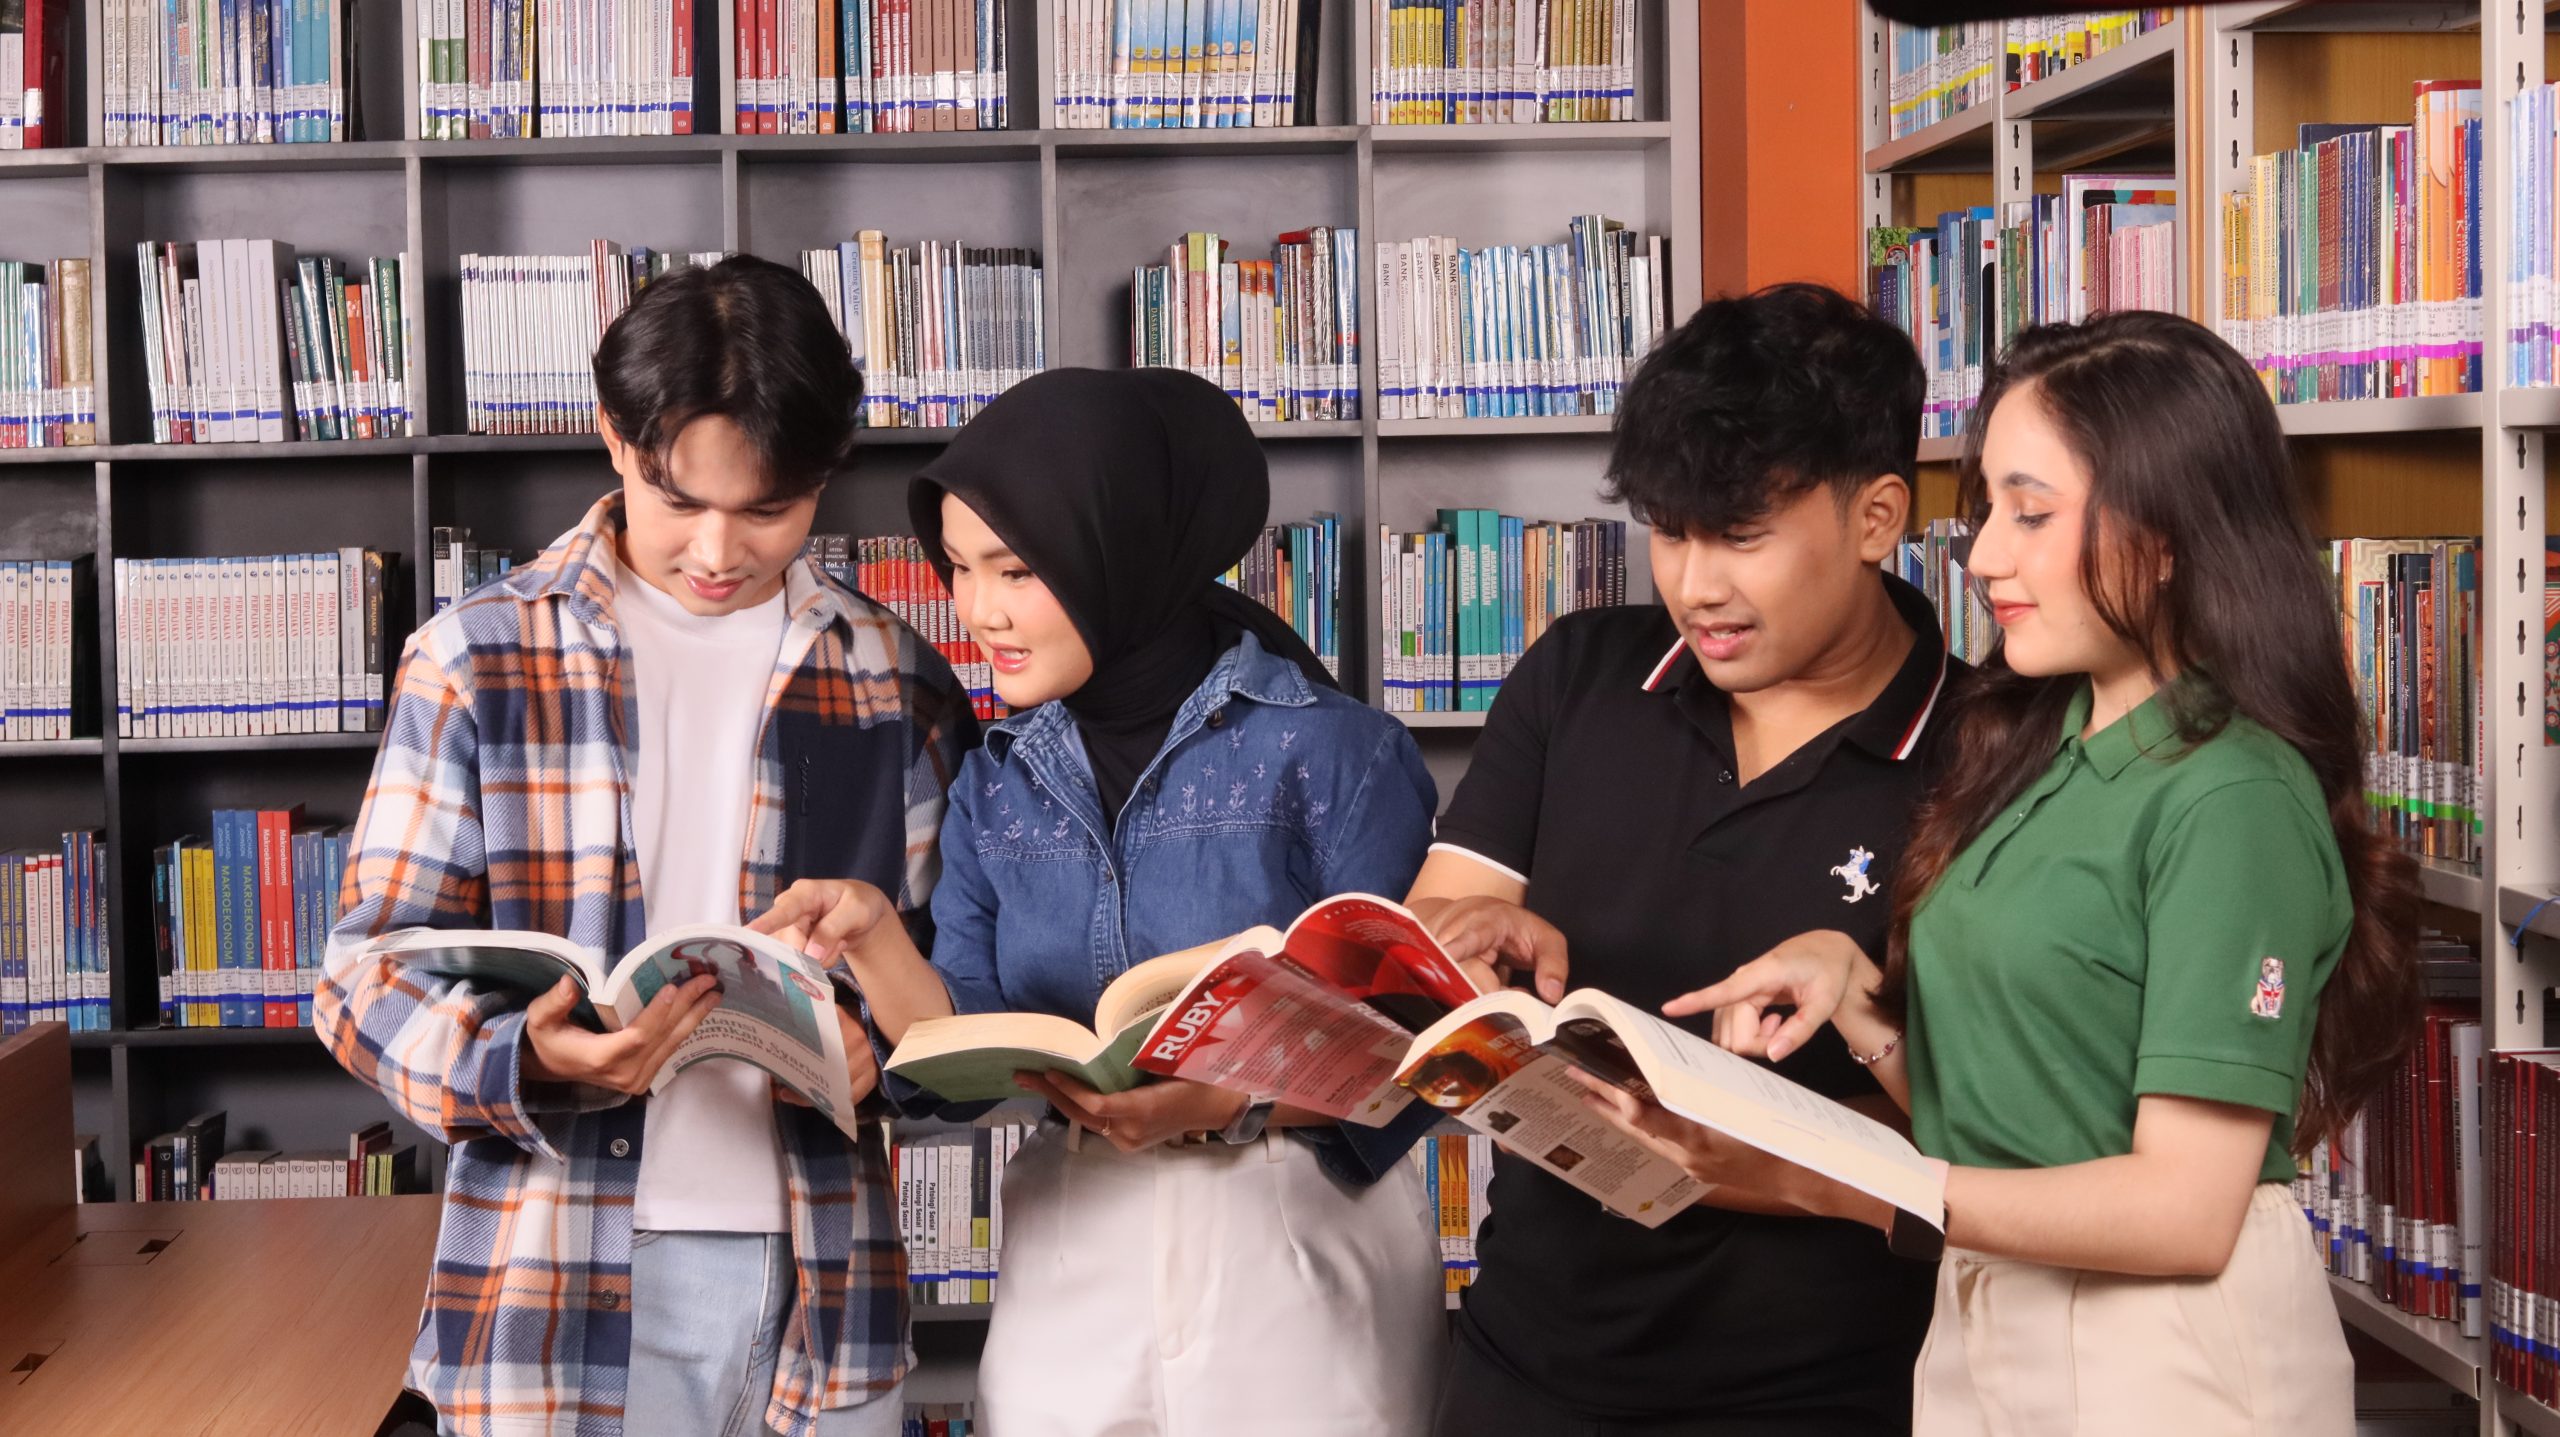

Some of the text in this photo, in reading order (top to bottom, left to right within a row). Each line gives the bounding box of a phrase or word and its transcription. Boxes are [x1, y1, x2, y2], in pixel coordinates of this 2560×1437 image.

[383, 268, 391, 298] Secrets
[851, 251, 860, 316] Creating Value
[1400, 253, 1408, 281] BANK
[1433, 254, 1441, 281] BANK
[1449, 255, 1457, 284] BANK
[297, 318, 302, 326] TO
[1150, 308, 1158, 358] DASAR-DASAR
[1461, 544, 1469, 606] KEWIRAUSAHAAN
[1482, 544, 1490, 606] KEWIRAUSAHAAN
[34, 600, 42, 643] PERPAJAKAN
[48, 601, 56, 645] PERPAJAKAN
[62, 601, 70, 645] PERPAJAKAN
[145, 599, 153, 642] PERPAJAKAN
[158, 598, 166, 642] PERPAJAKAN
[170, 598, 179, 641] PERPAJAKAN
[185, 597, 193, 640] PERPAJAKAN
[196, 596, 204, 640] PERPAJAKAN
[209, 598, 218, 640] PERPAJAKAN
[223, 596, 231, 640] PERPAJAKAN
[235, 596, 243, 639] PERPAJAKAN
[250, 595, 258, 638] PERPAJAKAN
[264, 595, 272, 638] PERPAJAKAN
[303, 592, 311, 635] PERPAJAKAN
[316, 593, 324, 636] PERPAJAKAN
[328, 592, 336, 636] PERPAJAKAN
[929, 600, 937, 642] KEWIRAUSAHAAN
[939, 600, 947, 643] KEWIRAUSAHAAN
[949, 599, 957, 641] KEWIRAUSAHAAN
[263, 828, 272, 886] Makroekonomi
[280, 829, 288, 886] Makroekonomi
[14, 863, 24, 960] TRANSFORMATIONAL COMPANIES
[221, 865, 232, 963] MAKROEKONOMI
[243, 865, 253, 963] MAKROEKONOMI
[2, 925, 11, 960] COMPANIES
[696, 1033, 720, 1042] dan
[1151, 990, 1224, 1062] RUBY
[769, 1041, 830, 1089] Syariah
[901, 1181, 909, 1208] Patologi
[914, 1180, 922, 1206] Patologi
